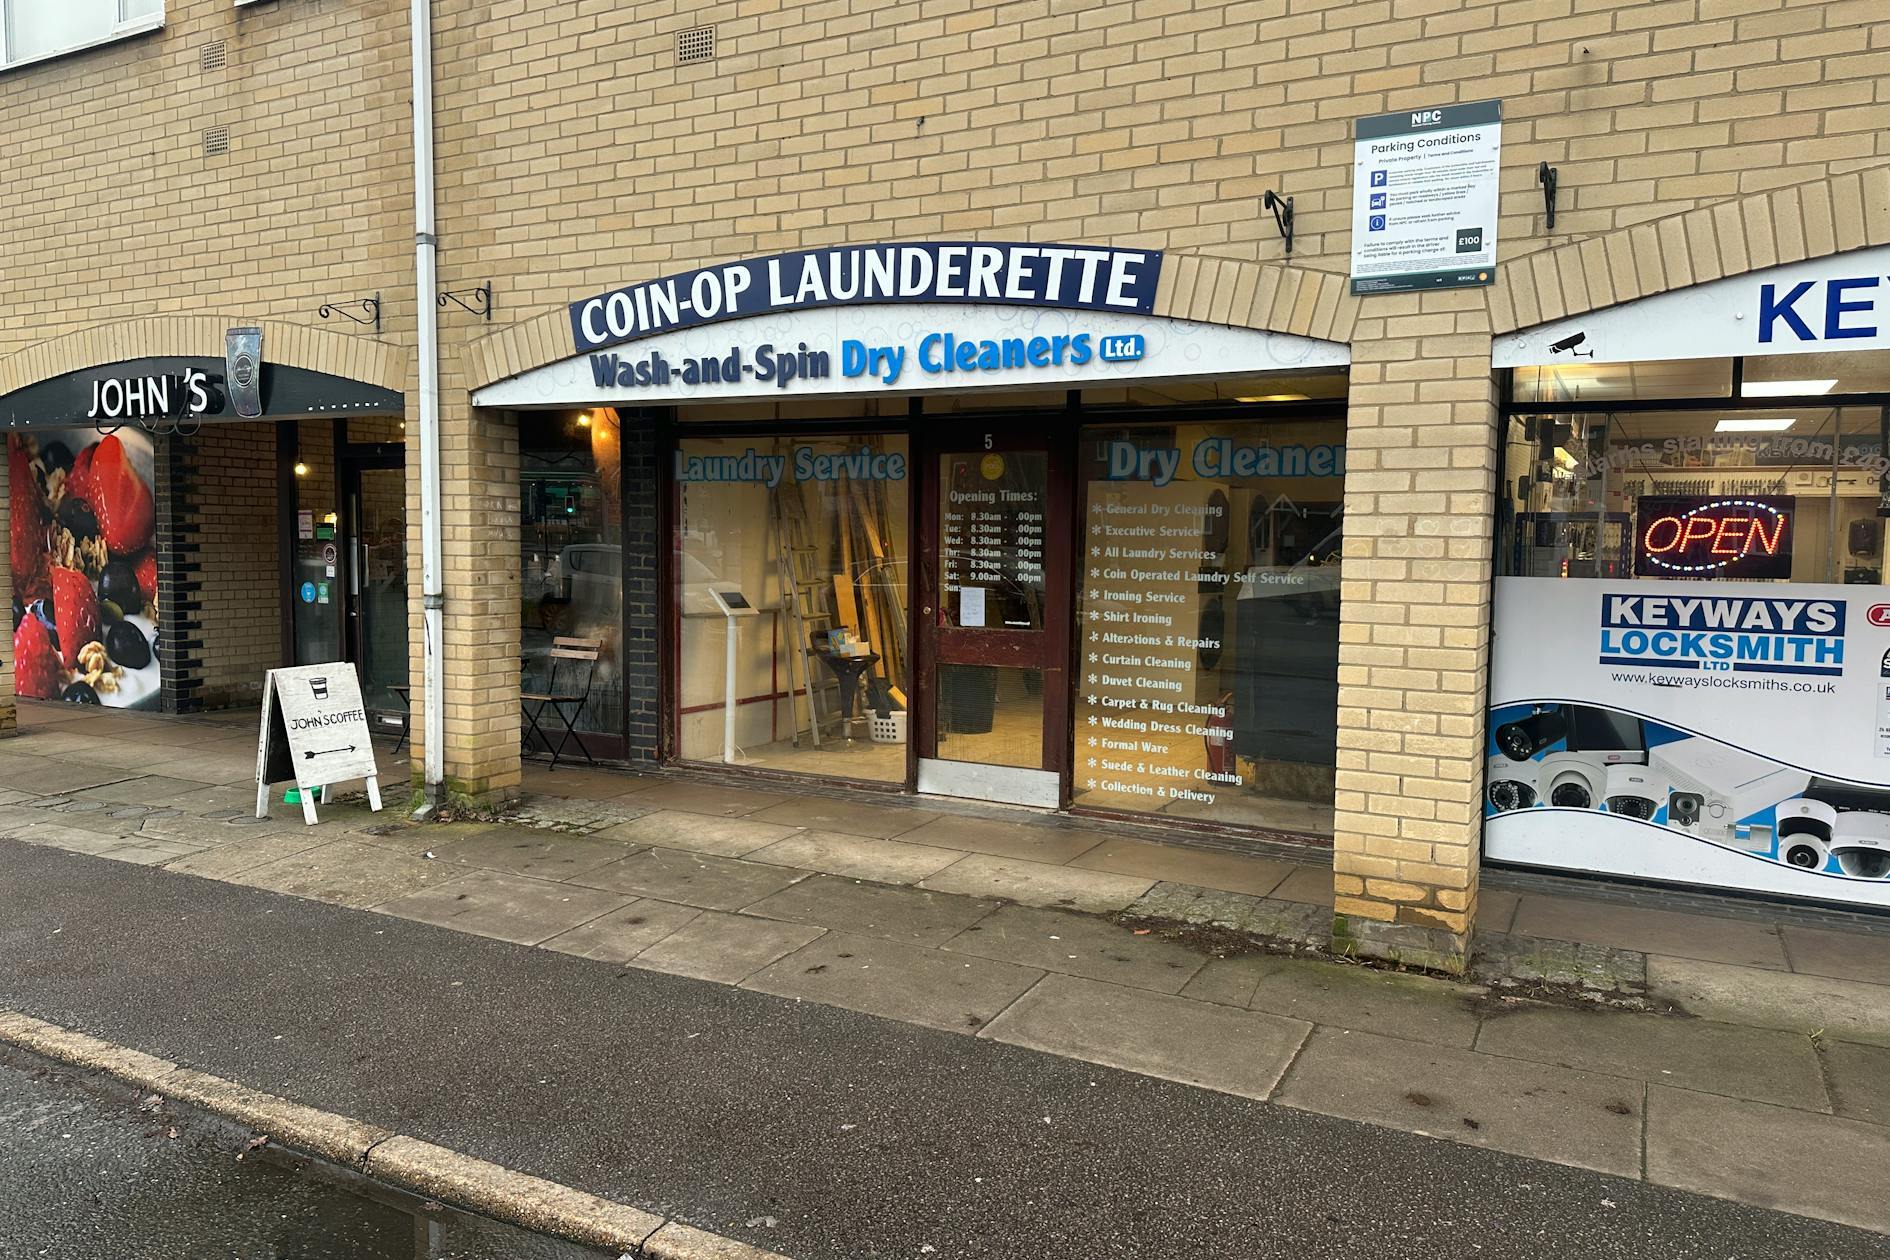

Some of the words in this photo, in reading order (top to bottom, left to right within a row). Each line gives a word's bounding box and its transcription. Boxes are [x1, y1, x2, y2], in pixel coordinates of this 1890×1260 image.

[1412, 110, 1441, 124] NPC
[1372, 141, 1414, 154] Parking
[1418, 133, 1481, 148] Conditions
[1398, 154, 1422, 162] Property
[1458, 236, 1480, 246] £100
[580, 265, 751, 344] COIN-OP
[768, 246, 1145, 307] LAUNDERETTE
[1758, 276, 1890, 343] KE
[589, 342, 829, 388] Wash-and-Spin
[842, 340, 905, 385] Dry
[919, 332, 1092, 373] Cleaners
[1105, 338, 1142, 358] Ltd.
[984, 434, 992, 449] 5
[675, 448, 784, 488] Laundry
[794, 446, 905, 481] Service
[1110, 440, 1180, 487] Dry
[950, 490, 995, 504] Opening
[1000, 490, 1038, 502] Times:
[971, 512, 1001, 520] 8.30am
[1106, 504, 1147, 514] General
[1151, 504, 1170, 517] Dry
[1174, 504, 1223, 518] Cleaning
[1105, 526, 1156, 537] Executive
[1159, 526, 1200, 537] Service
[1645, 516, 1785, 555] OPEN
[971, 537, 1001, 545] 8.30am
[971, 548, 1001, 557] 8.30am
[1105, 546, 1119, 557] All
[1122, 548, 1166, 561] Laundry
[1170, 549, 1216, 560] Services
[970, 560, 1001, 569] 8.30am
[1104, 568, 1127, 579] Coin
[1131, 568, 1180, 582] Operated
[1184, 571, 1230, 585] Laundry
[1234, 572, 1256, 584] Self
[1260, 573, 1304, 585] Service
[1104, 590, 1141, 604] Ironing
[1146, 592, 1185, 604] Service
[1104, 610, 1129, 623] Shirt
[1133, 613, 1172, 626] Ironing
[1610, 596, 1837, 633] KEYWAYS
[1102, 633, 1161, 646] Alterations
[1165, 636, 1174, 646] &
[1177, 636, 1220, 649] Repairs
[1600, 630, 1844, 664] LOCKSMITH
[1102, 654, 1141, 666] Curtain
[1144, 656, 1192, 671] Cleaning
[1703, 660, 1730, 671] LTD
[1102, 675, 1132, 687] Duvet
[1136, 676, 1182, 693] Cleaning
[1612, 672, 1836, 694] www.keywayslocksmiths.co.uk
[1101, 696, 1136, 710] Carpet
[1140, 699, 1148, 710] &
[1152, 700, 1174, 713] Rug
[1177, 702, 1226, 718] Cleaning
[1101, 717, 1147, 732] Wedding
[1151, 721, 1181, 734] Dress
[1186, 724, 1233, 741] Cleaning
[1101, 738, 1137, 750] Formal
[1142, 741, 1168, 754] Ware
[1101, 759, 1132, 772] Suede
[1136, 762, 1145, 773] &
[1149, 764, 1189, 778] Leather
[1194, 768, 1243, 785] Cleaning
[1101, 780, 1153, 795] Collection
[1157, 786, 1165, 797] &
[1170, 788, 1215, 804] Delivery
